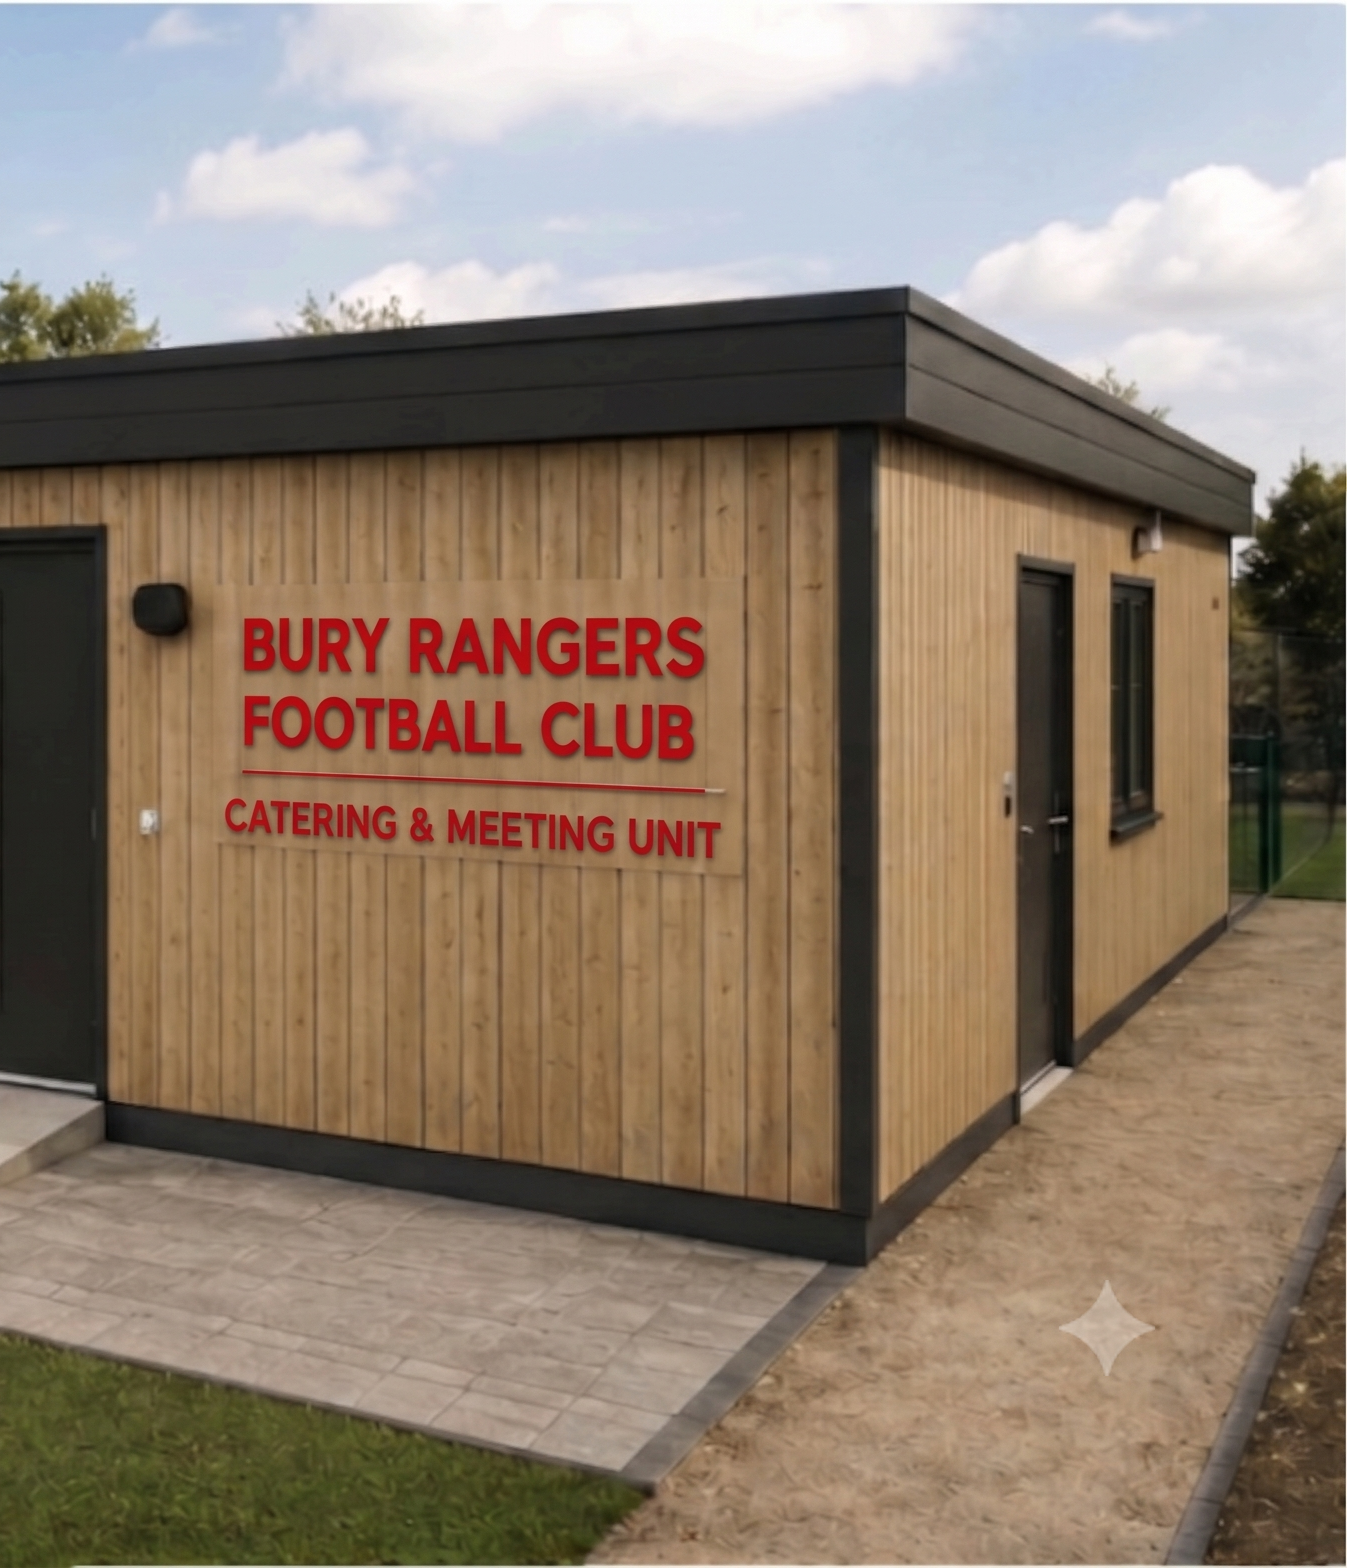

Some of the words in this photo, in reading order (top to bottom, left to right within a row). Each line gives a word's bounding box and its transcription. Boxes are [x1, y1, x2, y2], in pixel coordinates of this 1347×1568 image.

[242, 616, 391, 675] BURY
[408, 615, 706, 679] RANGERS
[242, 694, 523, 756] FOOTBALL
[539, 700, 696, 762] CLUB
[224, 796, 398, 842] CATERING
[408, 805, 435, 844] &
[447, 807, 616, 855] MEETING
[627, 816, 723, 860] UNIT
